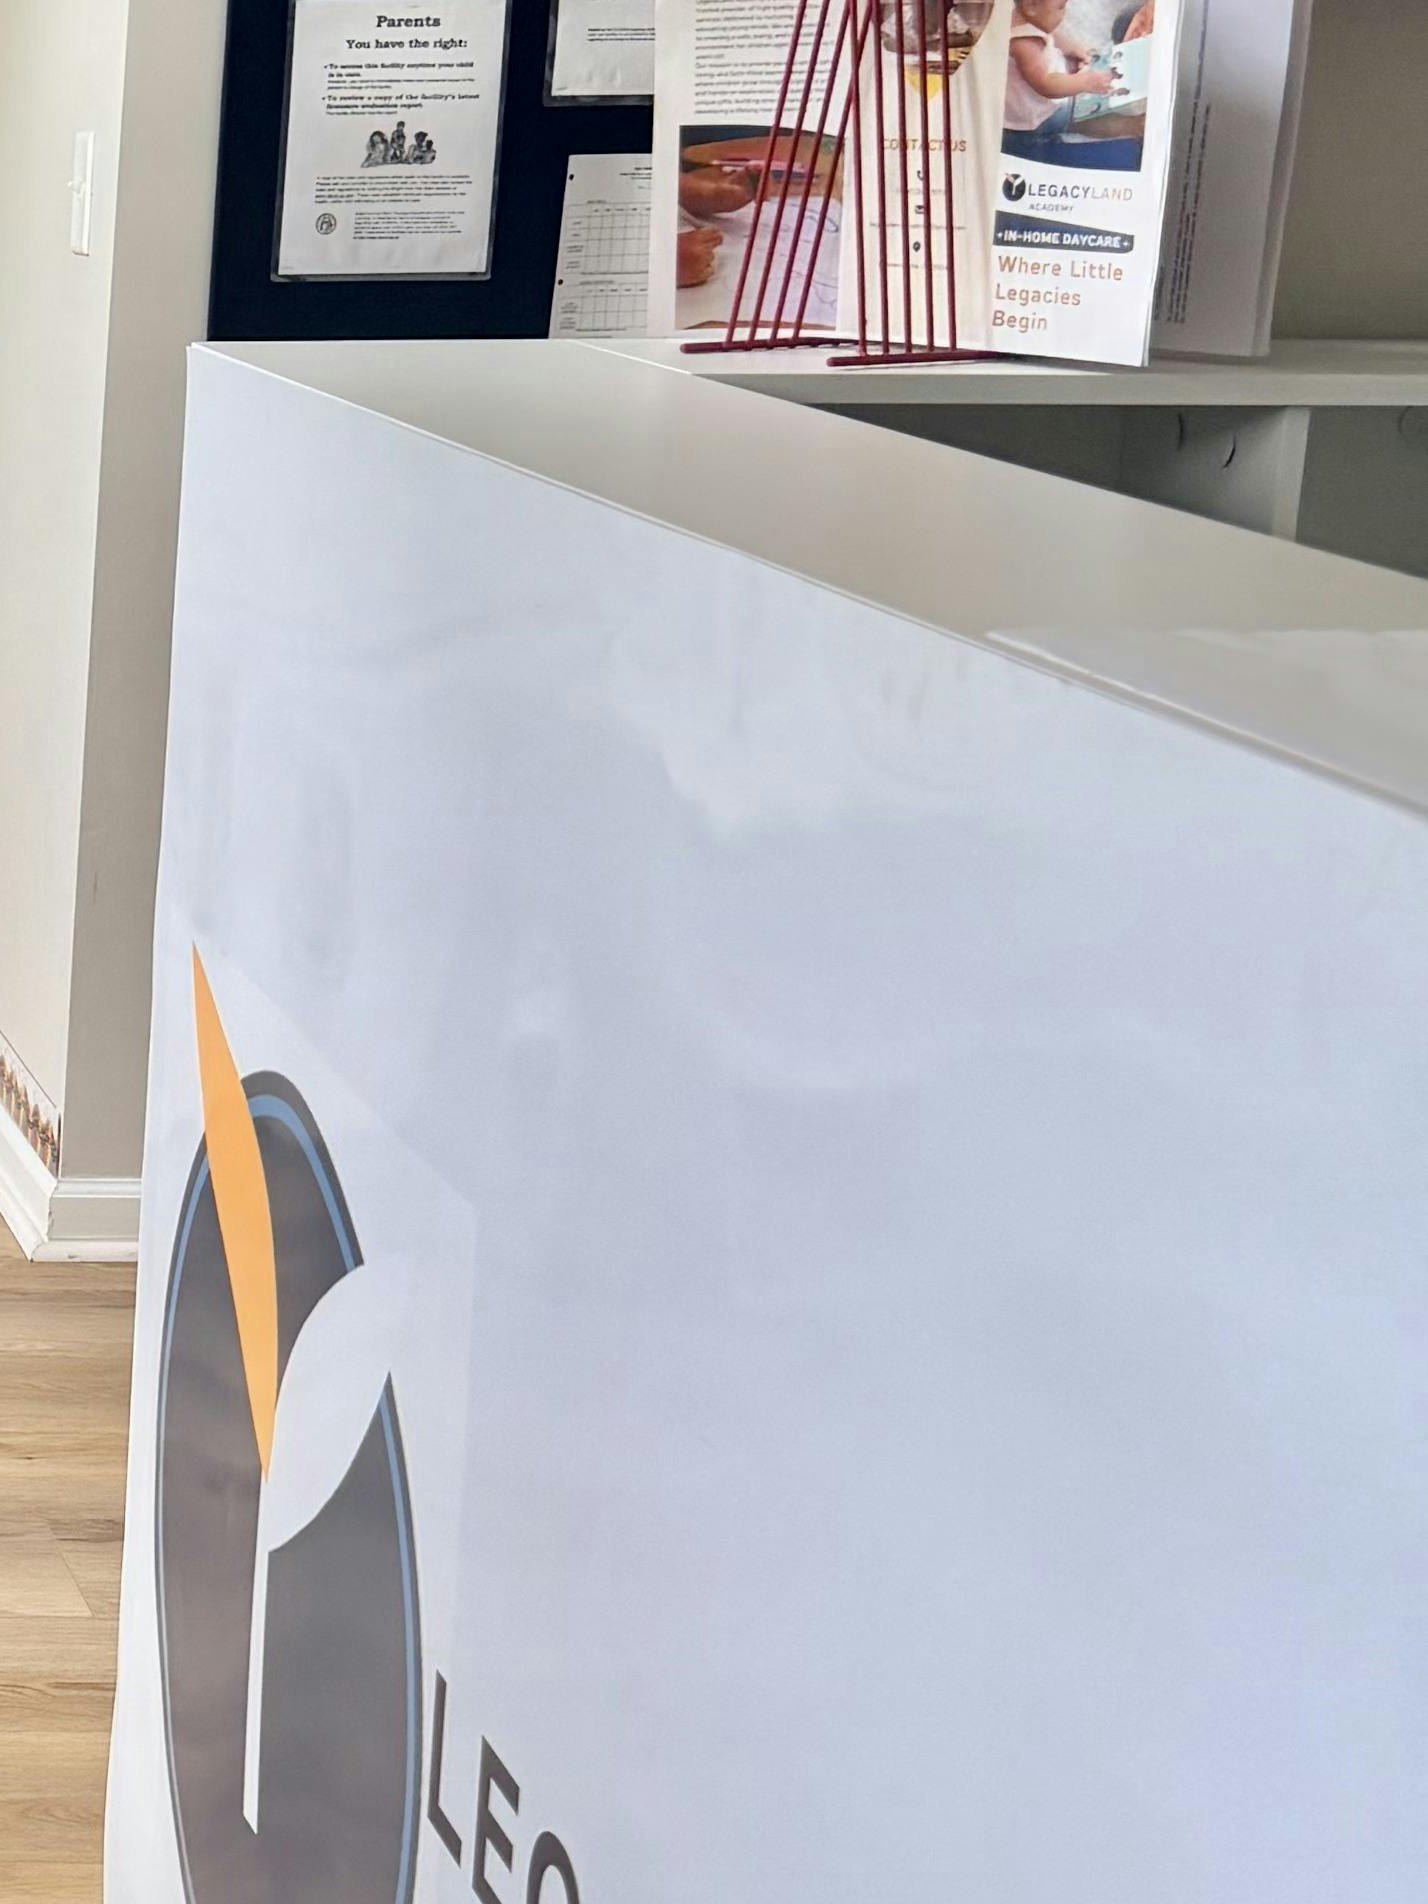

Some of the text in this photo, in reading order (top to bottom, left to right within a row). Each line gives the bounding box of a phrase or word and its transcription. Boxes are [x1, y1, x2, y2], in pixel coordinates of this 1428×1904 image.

[376, 14, 441, 28] Parents
[346, 37, 468, 51] You have the right:
[1028, 183, 1134, 202] LEGACYLAND
[1028, 202, 1074, 213] ACADEMY
[1003, 229, 1121, 249] IN-HOME DAYCARE
[998, 255, 1124, 282] Where Little
[995, 283, 1081, 307] Legacies
[991, 309, 1048, 334] Begin
